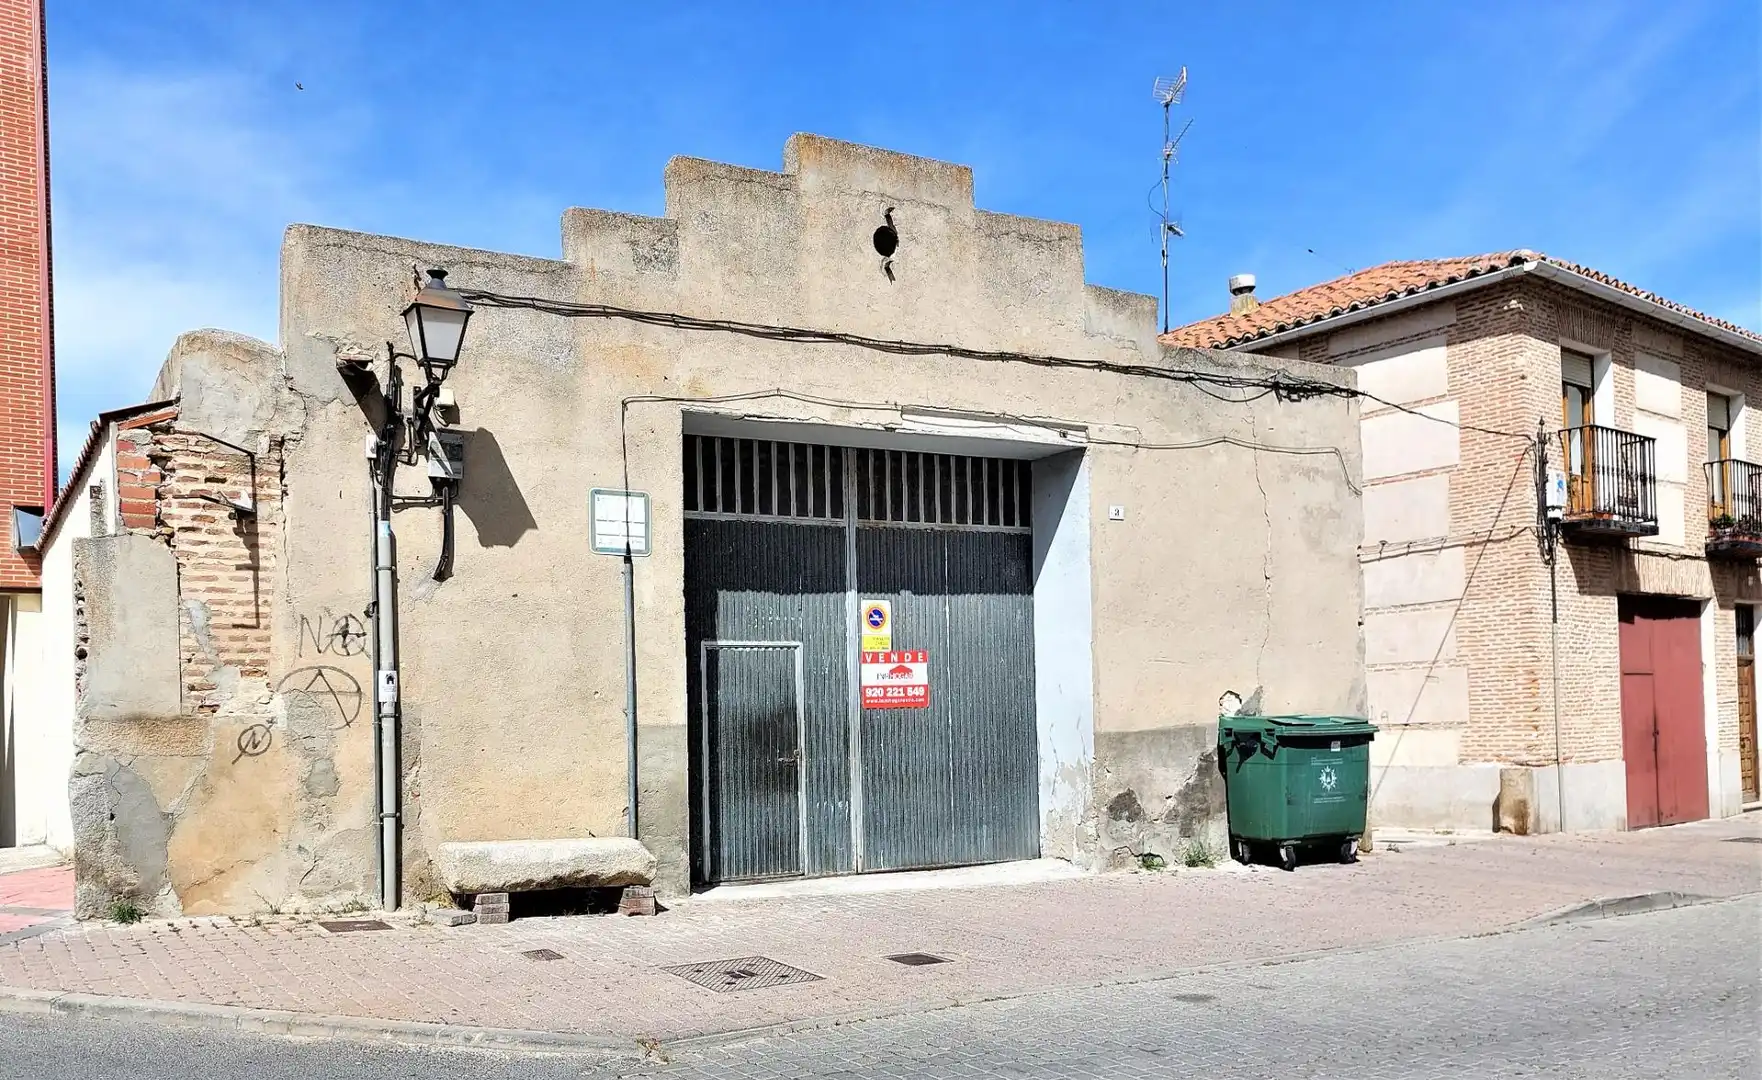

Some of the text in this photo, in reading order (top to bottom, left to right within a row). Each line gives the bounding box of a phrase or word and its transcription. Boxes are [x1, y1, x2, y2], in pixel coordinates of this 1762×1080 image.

[865, 652, 924, 663] VENDE
[865, 686, 925, 697] 920 221 549
